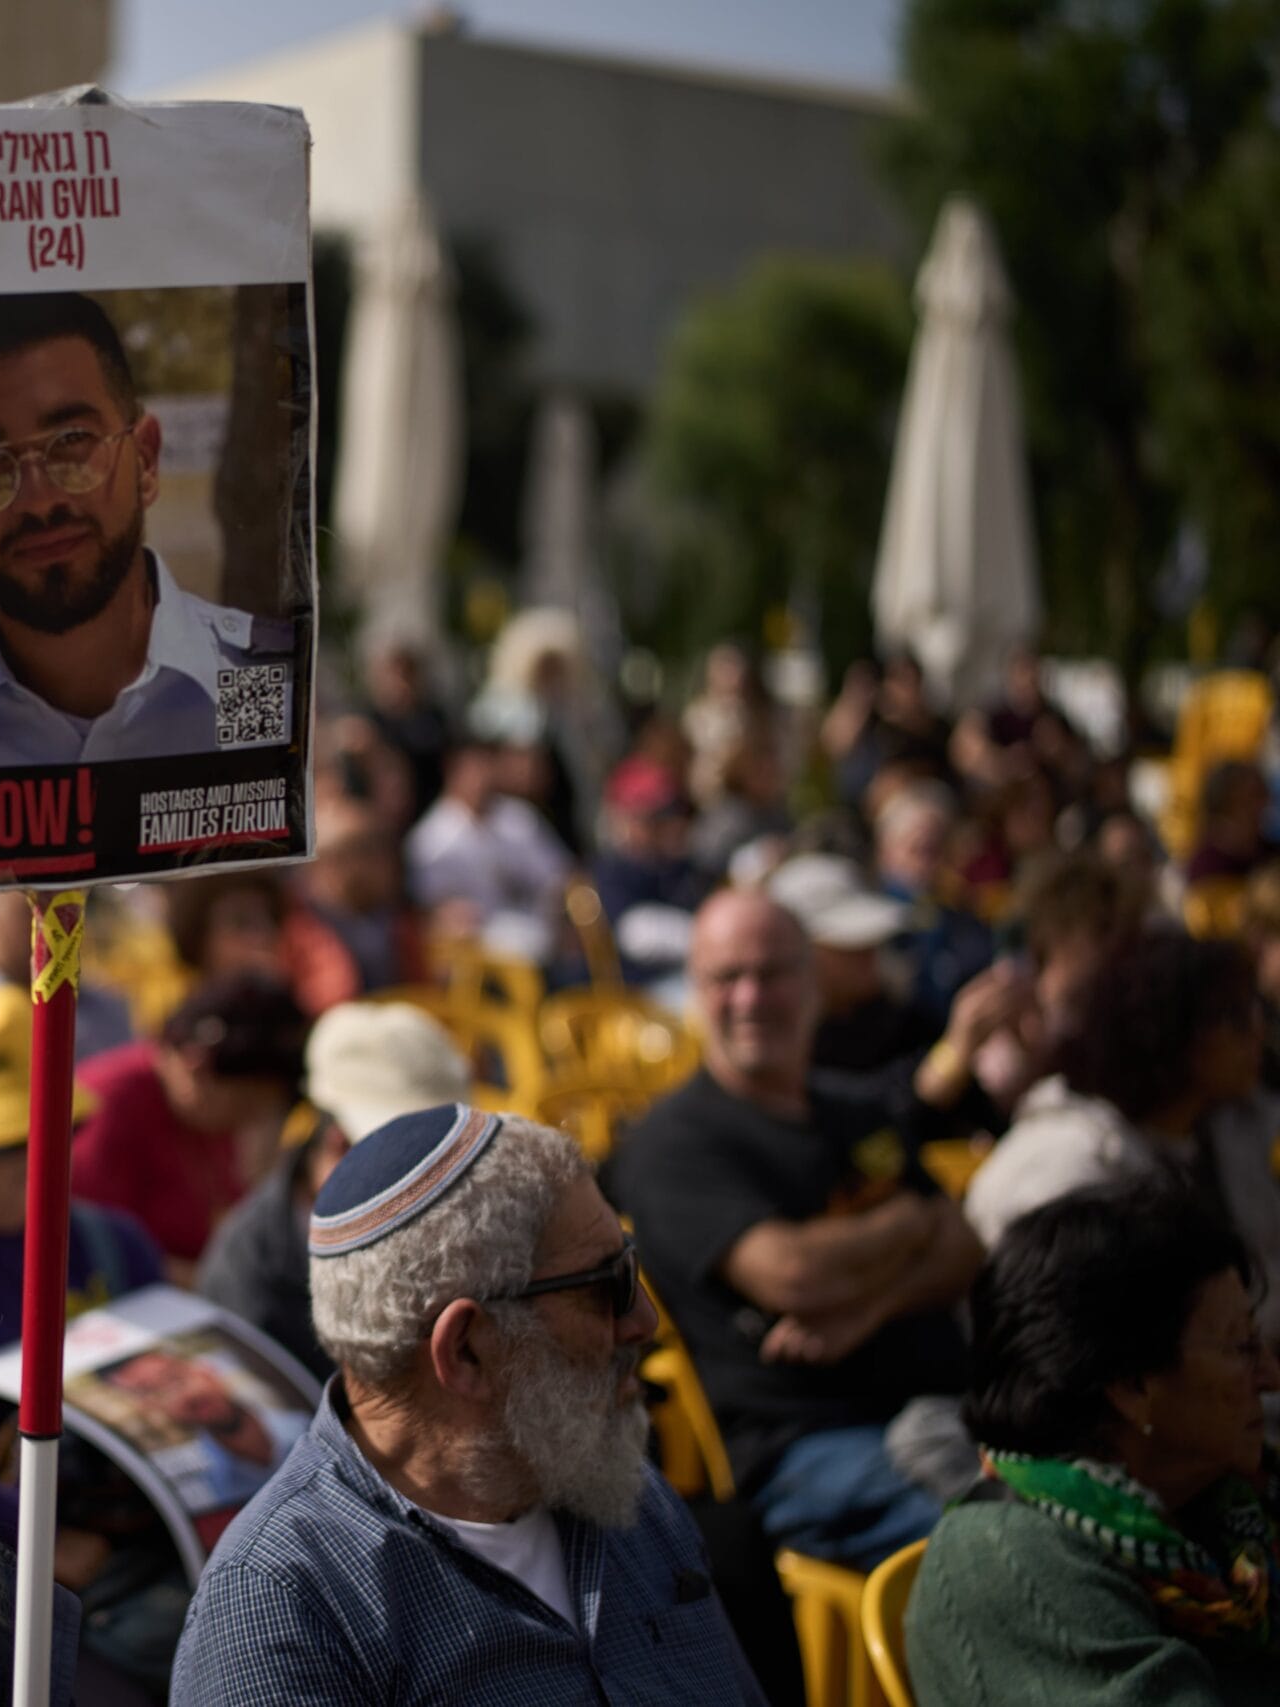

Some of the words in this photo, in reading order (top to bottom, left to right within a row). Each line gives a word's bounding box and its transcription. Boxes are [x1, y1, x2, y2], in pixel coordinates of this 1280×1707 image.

[83, 130, 111, 176] רן
[52, 177, 119, 219] GVILI
[28, 222, 85, 272] (24)
[140, 787, 204, 814] HOSTAGES
[206, 784, 231, 807] AND
[233, 777, 286, 804] MISSING
[140, 808, 220, 846] FAMILIES
[222, 800, 286, 834] FORUM
